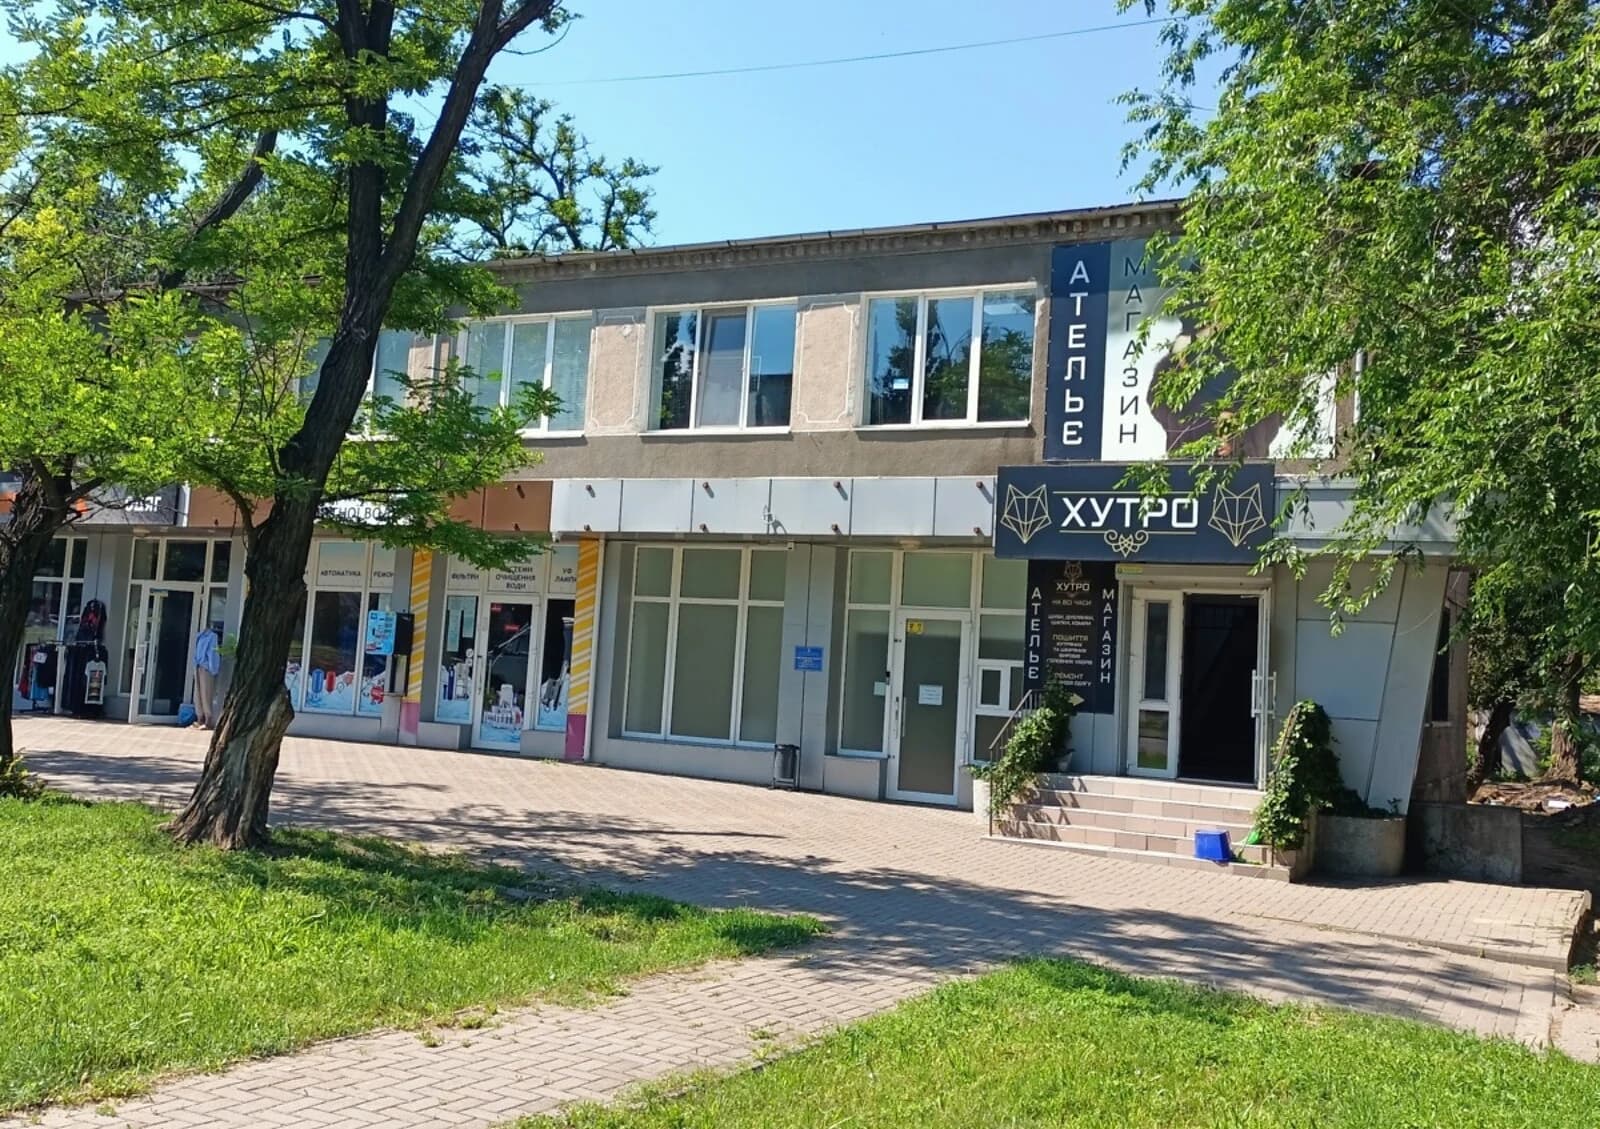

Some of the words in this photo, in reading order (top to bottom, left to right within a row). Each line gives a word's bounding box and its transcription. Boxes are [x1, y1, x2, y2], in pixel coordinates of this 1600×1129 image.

[1062, 260, 1091, 445] АТЕЛЬЄ
[1119, 256, 1147, 444] МАГАЗИН
[1061, 497, 1199, 529] ХУТРО
[495, 574, 536, 582] ОЧИЩЕННЯ
[506, 582, 526, 590] ВОДИ
[1056, 582, 1090, 591] ХУТРО
[1028, 586, 1042, 679] АТЕЛЬЄ
[1100, 588, 1115, 684] МАГАЗИН
